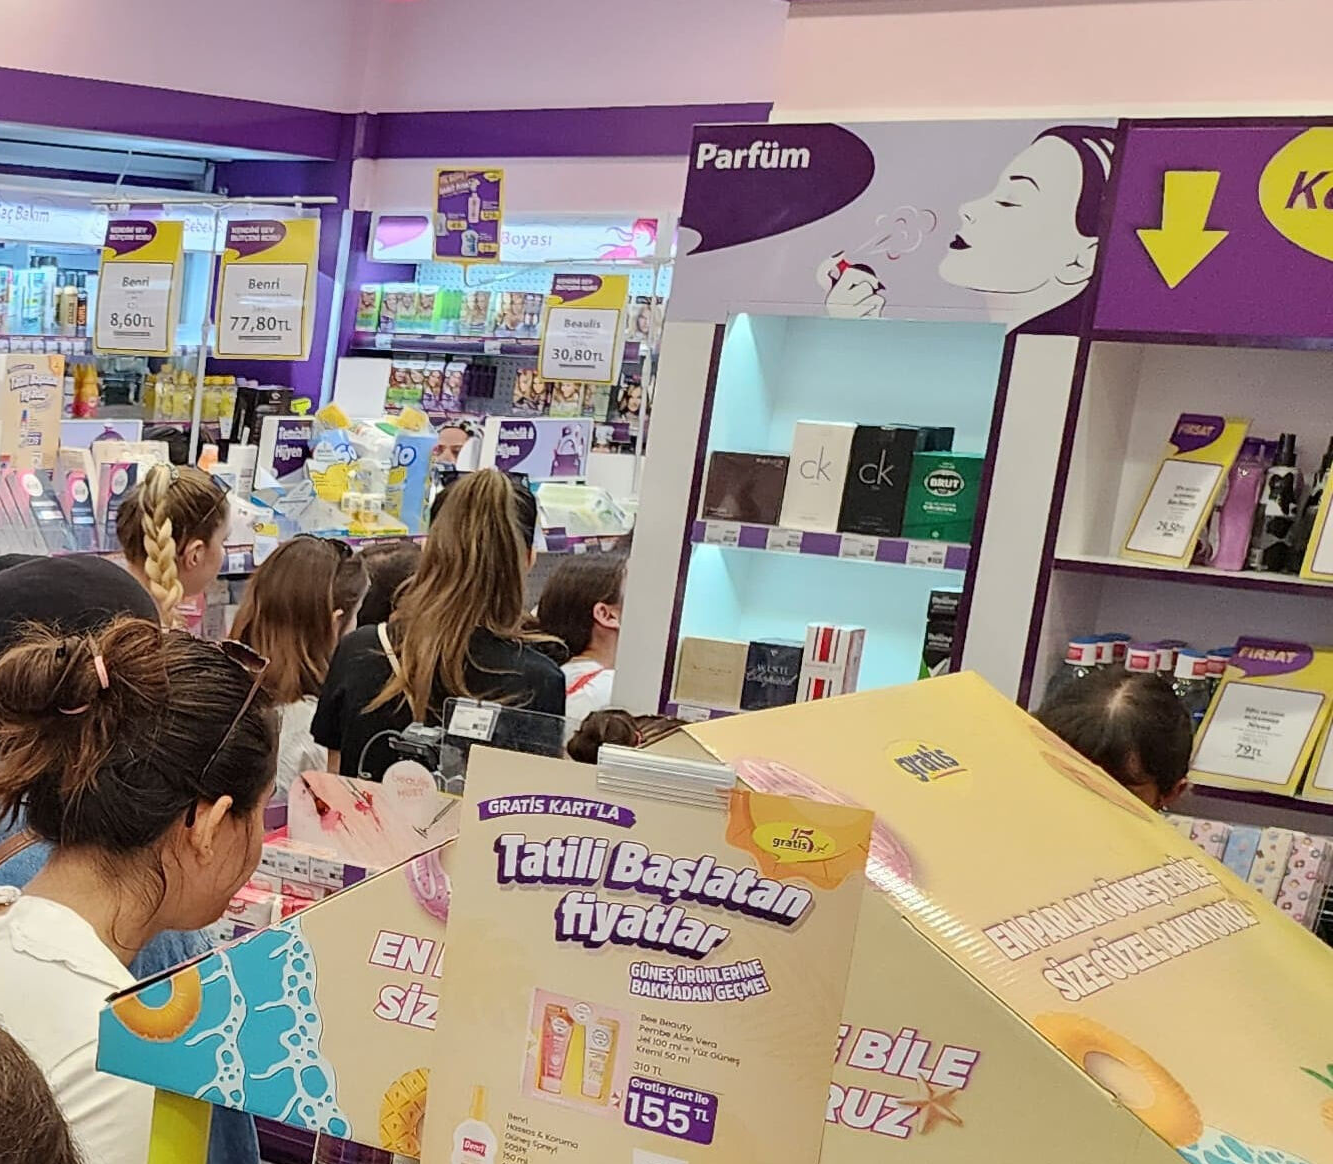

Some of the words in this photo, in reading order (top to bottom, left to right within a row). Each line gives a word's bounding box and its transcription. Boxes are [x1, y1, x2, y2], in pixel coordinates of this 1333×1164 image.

[695, 140, 811, 170] Parfüm
[122, 277, 150, 287] Benri
[248, 278, 281, 290] Benri
[110, 313, 155, 328] 8,60TL
[230, 316, 292, 333] 77,80TL
[563, 318, 601, 329] Beaulis
[551, 348, 604, 362] 30,80TL
[1178, 424, 1215, 438] FIRSAT
[799, 446, 831, 482] ck
[859, 449, 894, 486] ck
[929, 476, 959, 489] BRUT
[1238, 645, 1298, 666] FIRSAT
[894, 744, 959, 782] gratis
[488, 797, 544, 814] GRATİS
[549, 799, 619, 820] KART'LA
[773, 837, 808, 851] gratis
[494, 834, 609, 886] Tatili
[604, 841, 813, 926] Başlatan
[983, 917, 1036, 961] EN
[1029, 892, 1115, 947] PARLAK
[1091, 866, 1184, 917] GÜNEŞTE
[1167, 854, 1220, 897] BİLE
[555, 891, 731, 960] fiyatlar
[367, 929, 435, 975] EN
[1043, 955, 1114, 1001] SİZE
[1089, 932, 1169, 980] GÜZEL
[1146, 899, 1260, 958] BAKIYORUZ
[630, 961, 675, 985] GÜNEŞ
[675, 958, 765, 984] ÜRÜNLERİNE
[630, 979, 714, 1001] BAKMADAN
[714, 976, 771, 1001] GEÇME!
[372, 982, 440, 1031] SİZ
[696, 1037, 718, 1049] Vera
[633, 1062, 650, 1072] 310
[652, 1066, 662, 1076] TL
[847, 1026, 981, 1089] BİLE
[631, 1078, 666, 1095] Gratis
[667, 1087, 694, 1102] Kart
[695, 1093, 709, 1106] ile
[628, 1092, 691, 1134] 155
[693, 1109, 710, 1122] TL
